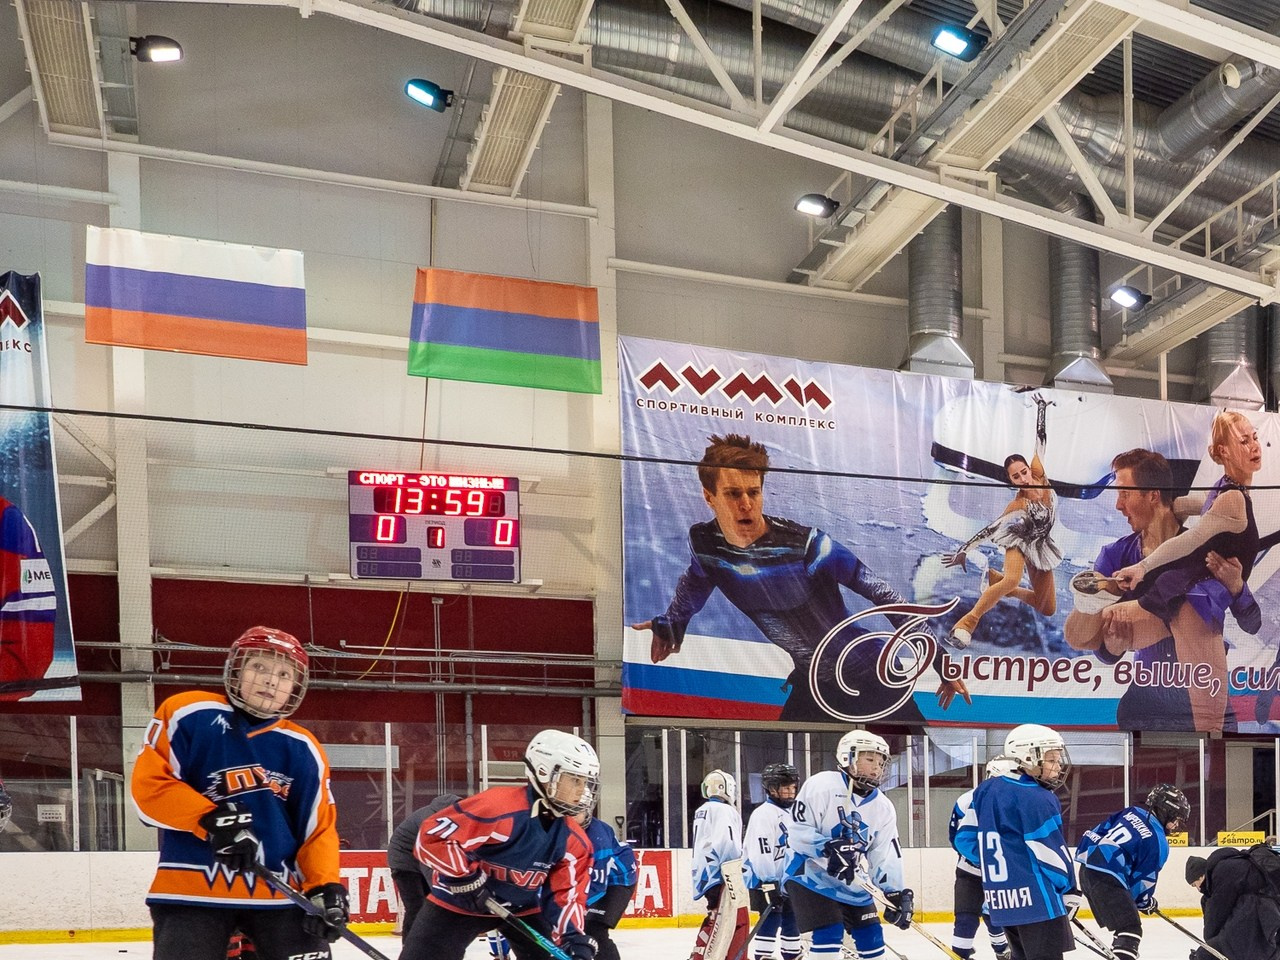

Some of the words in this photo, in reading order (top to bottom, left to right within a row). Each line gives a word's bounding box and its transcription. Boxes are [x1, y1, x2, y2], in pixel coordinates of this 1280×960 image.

[636, 398, 744, 420] СПОРТИВНЫЙ
[755, 411, 836, 430] КОМПЛЕКС
[359, 472, 405, 486] СПОРТ
[419, 475, 447, 488] ЭТО
[394, 488, 485, 516] 13:59
[376, 515, 395, 541] 0
[436, 528, 443, 547] 1
[494, 520, 513, 545] 0
[809, 596, 1103, 723] Быстрее,
[1113, 659, 1222, 698] выше,
[216, 813, 253, 828] CC
[791, 800, 807, 823] 18
[425, 816, 460, 840] 71
[758, 837, 772, 855] 15
[977, 831, 1008, 883] 13
[724, 873, 737, 901] CCM
[984, 886, 1034, 910] РЕЛИЯ
